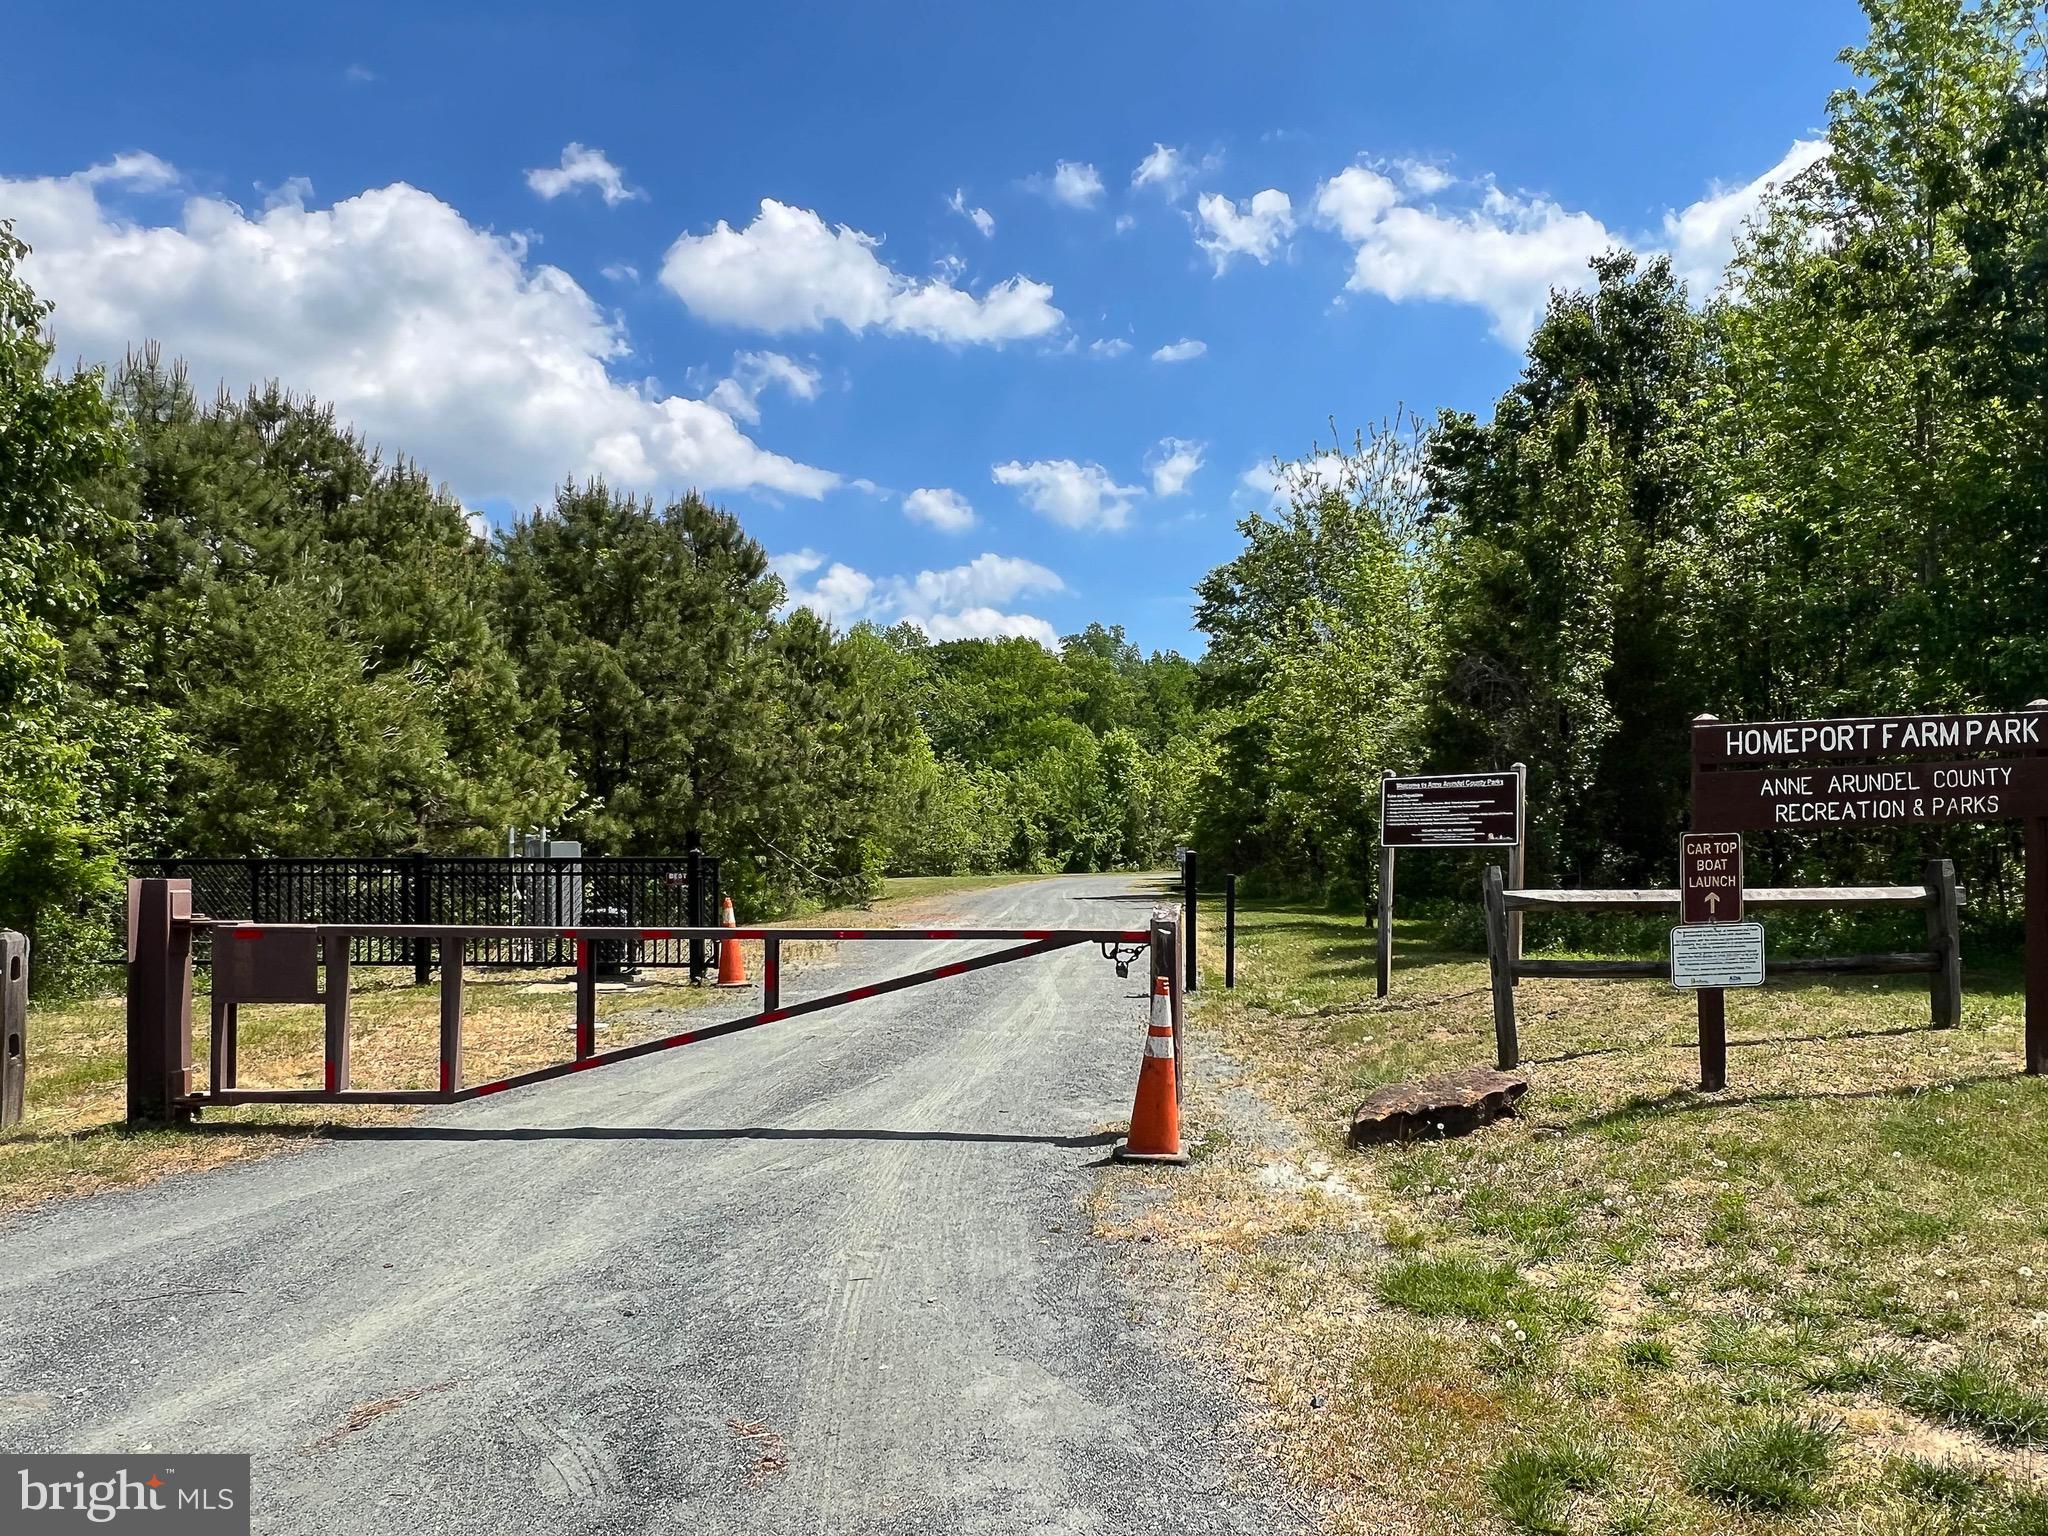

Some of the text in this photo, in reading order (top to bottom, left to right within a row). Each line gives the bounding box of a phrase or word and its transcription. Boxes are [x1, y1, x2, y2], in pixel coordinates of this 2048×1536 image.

[1727, 717, 2040, 755] HOMEPORT FARM PARK
[1760, 766, 2013, 797] ANNE ARUNDEL COUNTY
[1775, 795, 1999, 823] RECREATION & PARKS
[1687, 842, 1737, 855] CAR TOP
[1696, 859, 1728, 871] BOAT
[1689, 875, 1736, 888] LAUNCH
